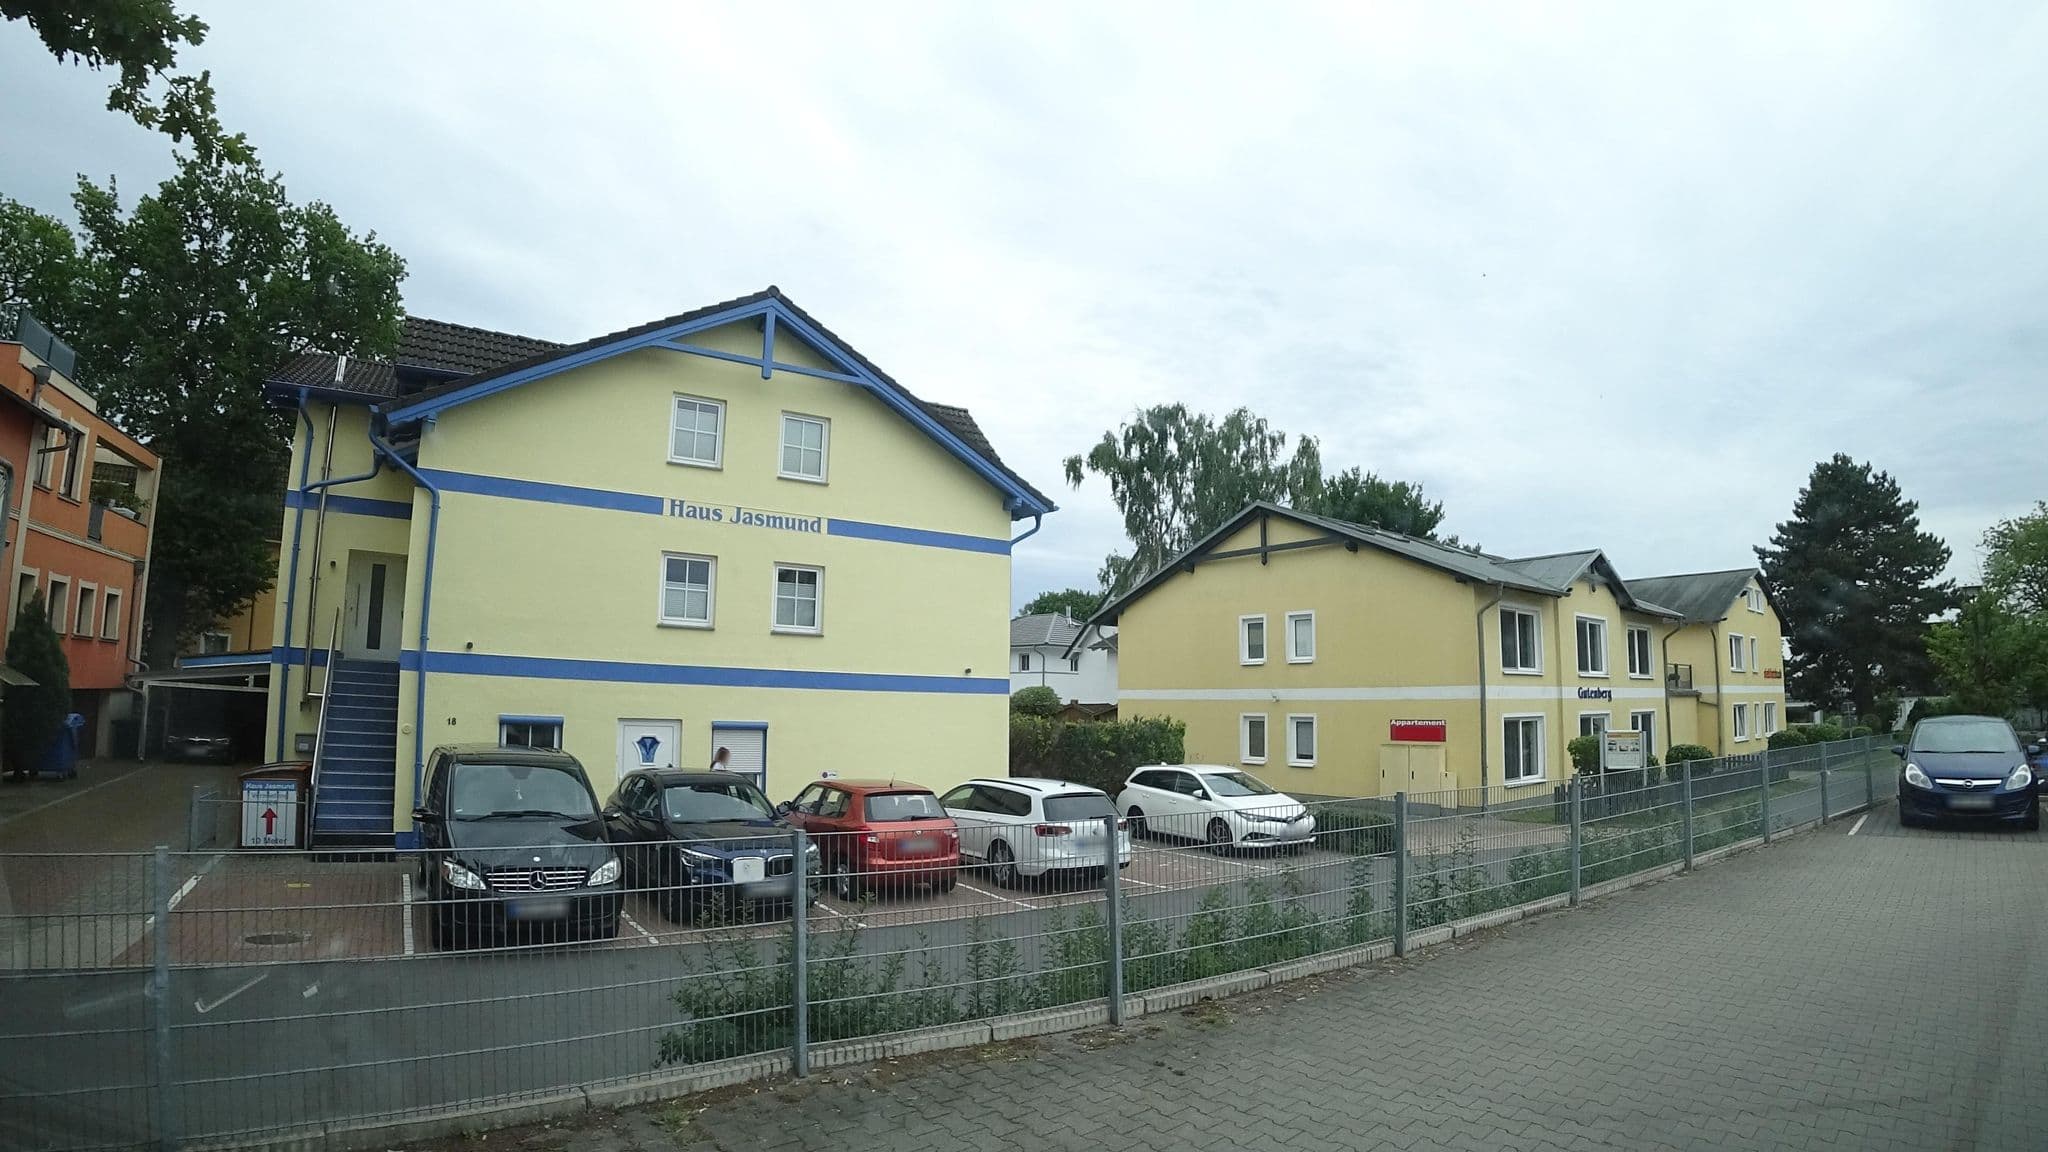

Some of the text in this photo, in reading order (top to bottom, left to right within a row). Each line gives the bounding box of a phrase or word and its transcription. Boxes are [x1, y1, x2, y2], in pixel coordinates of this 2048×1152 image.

[670, 499, 821, 533] Haus Jasmund
[1577, 687, 1612, 702] Gutenberg
[447, 717, 457, 726] 18
[1391, 719, 1446, 727] Appartement
